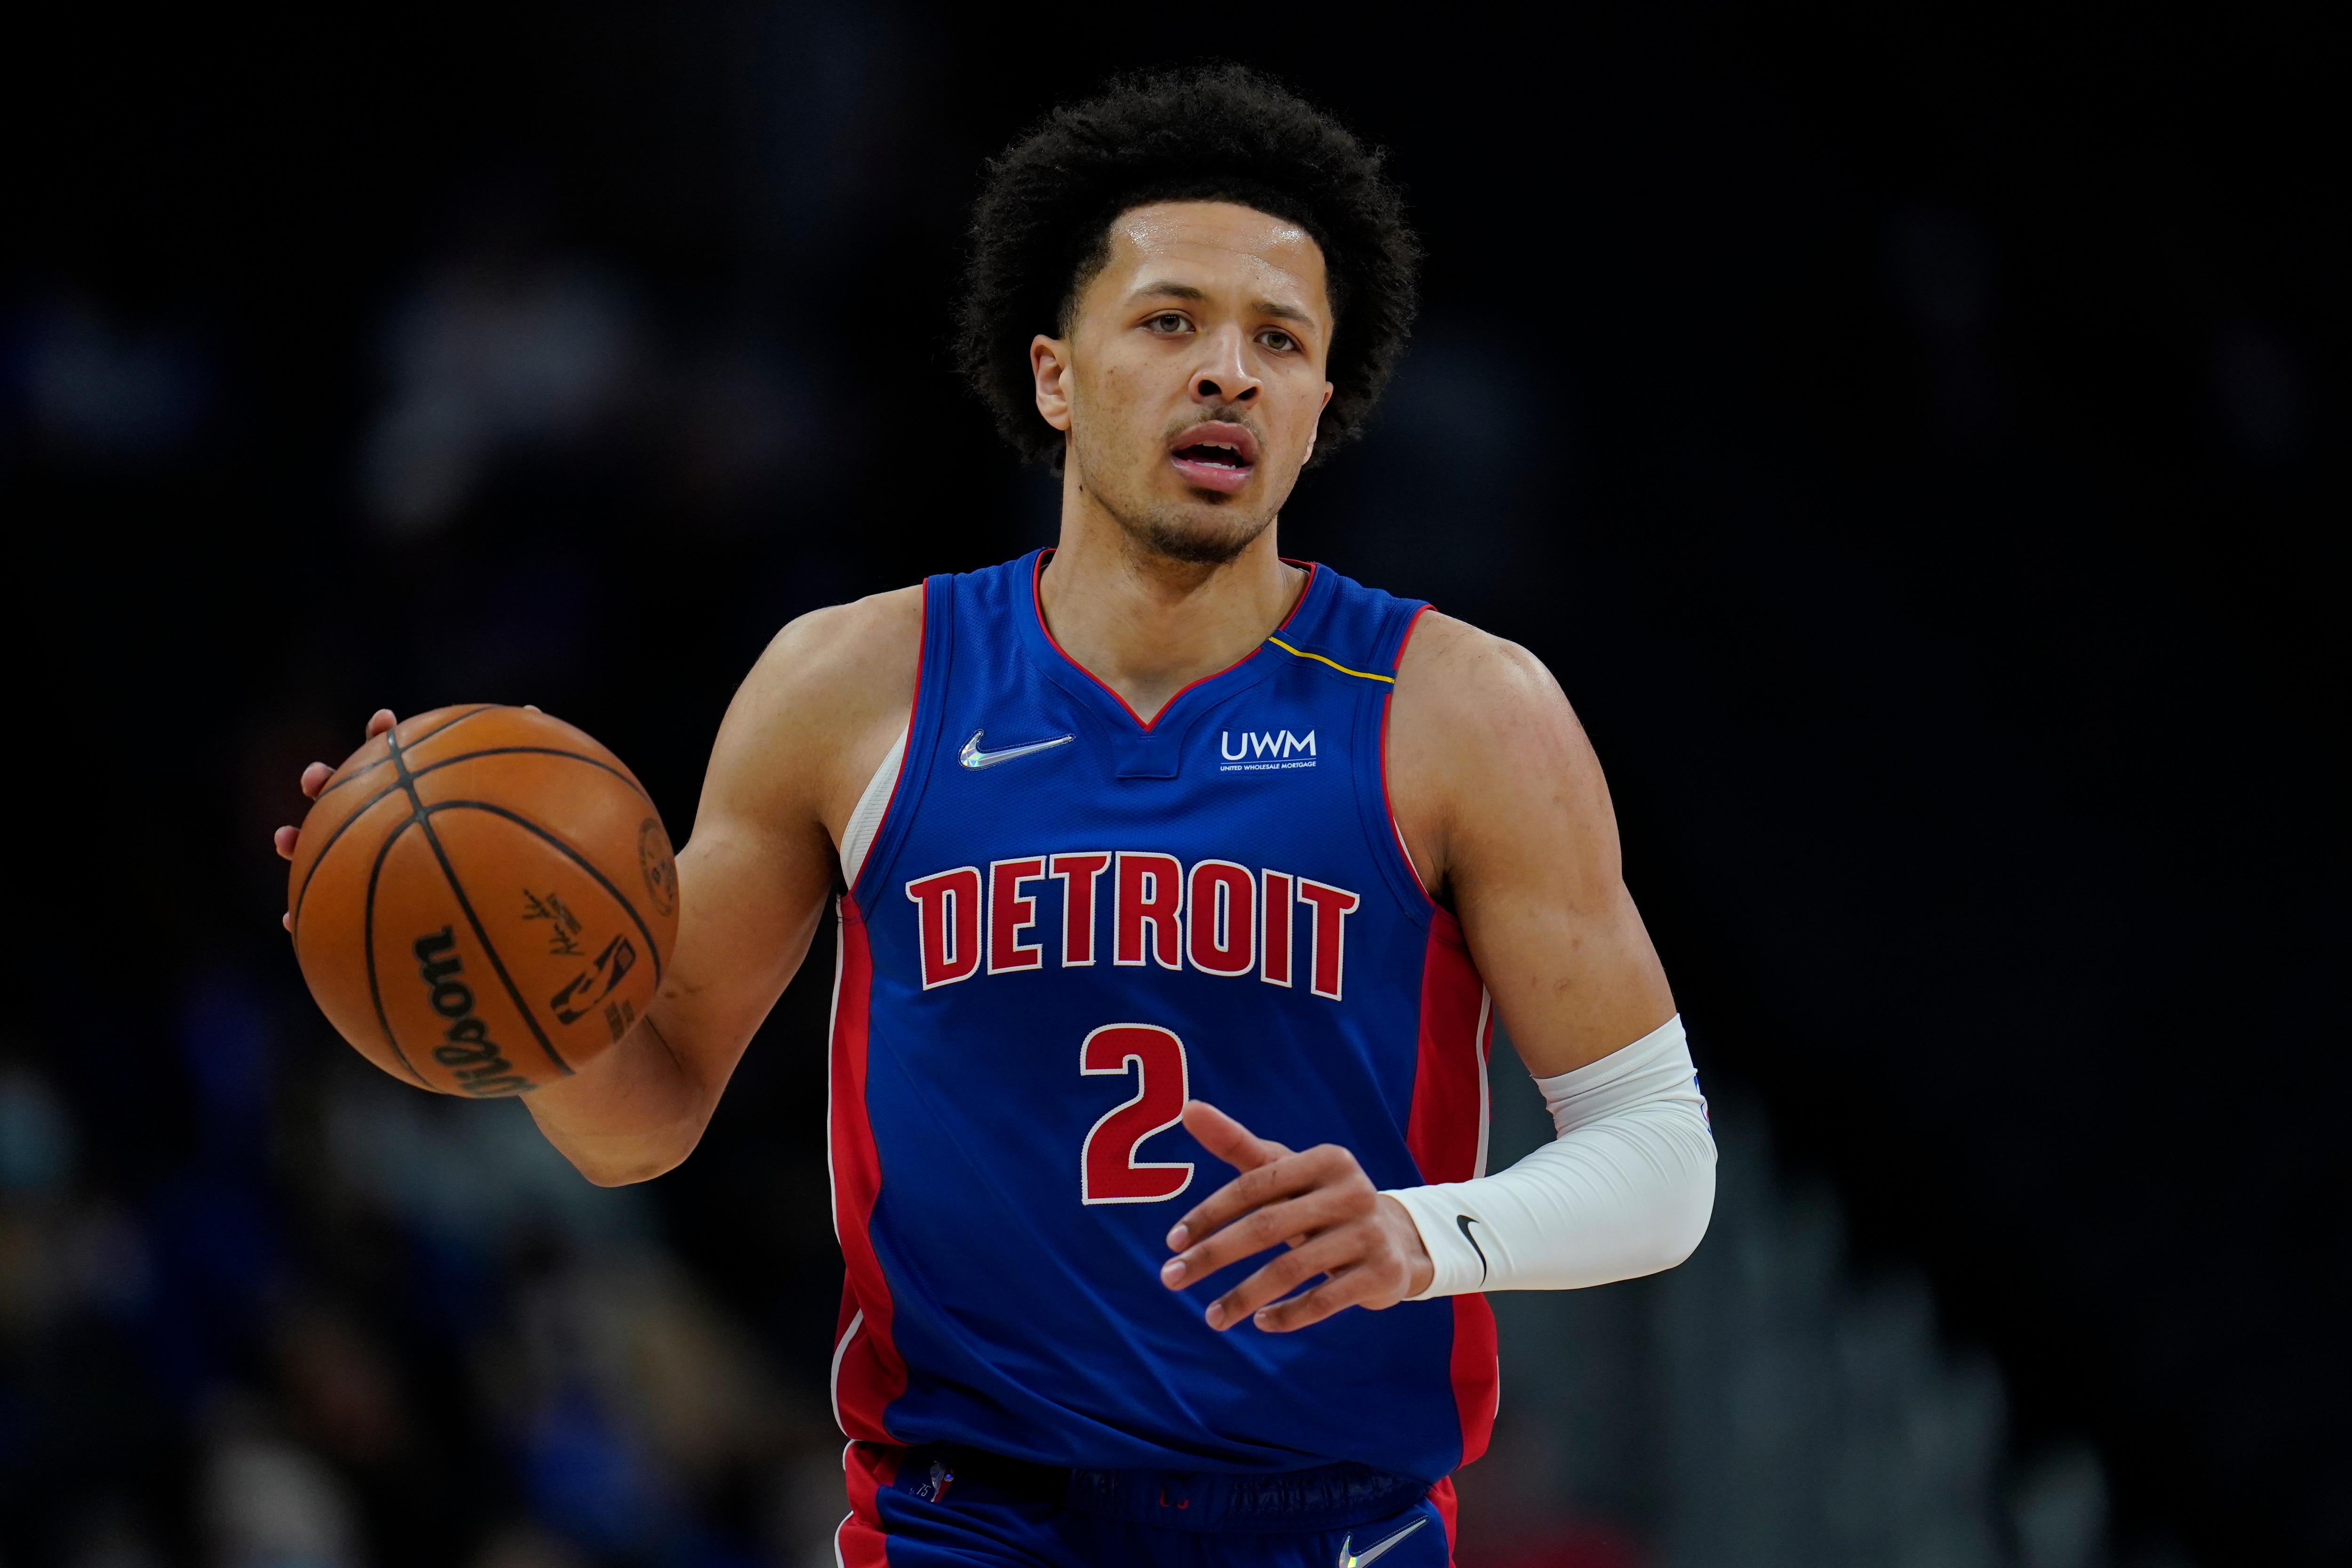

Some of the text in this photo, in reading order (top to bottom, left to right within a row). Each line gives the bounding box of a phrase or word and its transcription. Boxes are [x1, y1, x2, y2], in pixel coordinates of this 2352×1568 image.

[1221, 729, 1316, 760] UWM
[906, 851, 1360, 1001] DETROIT
[1080, 1022, 1195, 1205] 2
